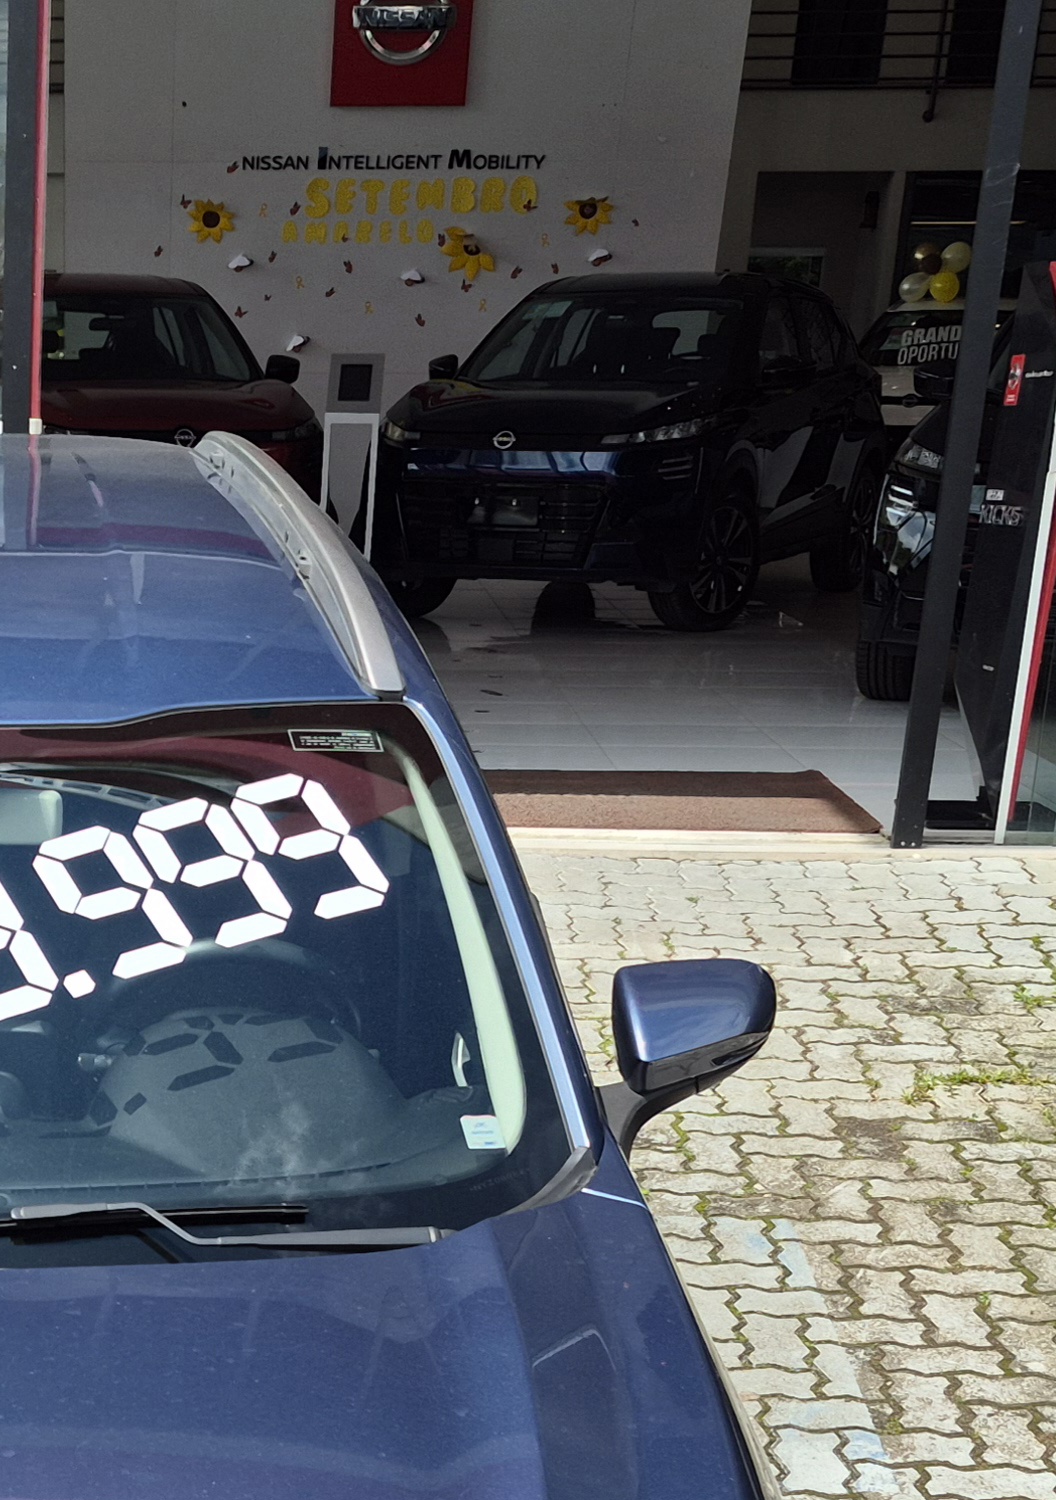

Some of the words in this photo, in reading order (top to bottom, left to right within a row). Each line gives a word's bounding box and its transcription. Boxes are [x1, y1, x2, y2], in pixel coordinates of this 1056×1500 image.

[242, 154, 310, 171] NISSAN
[317, 146, 443, 171] INTELLIGENT
[448, 148, 547, 171] MOBILITY
[304, 174, 539, 219] SETEMBRO
[281, 219, 436, 245] AMARELO
